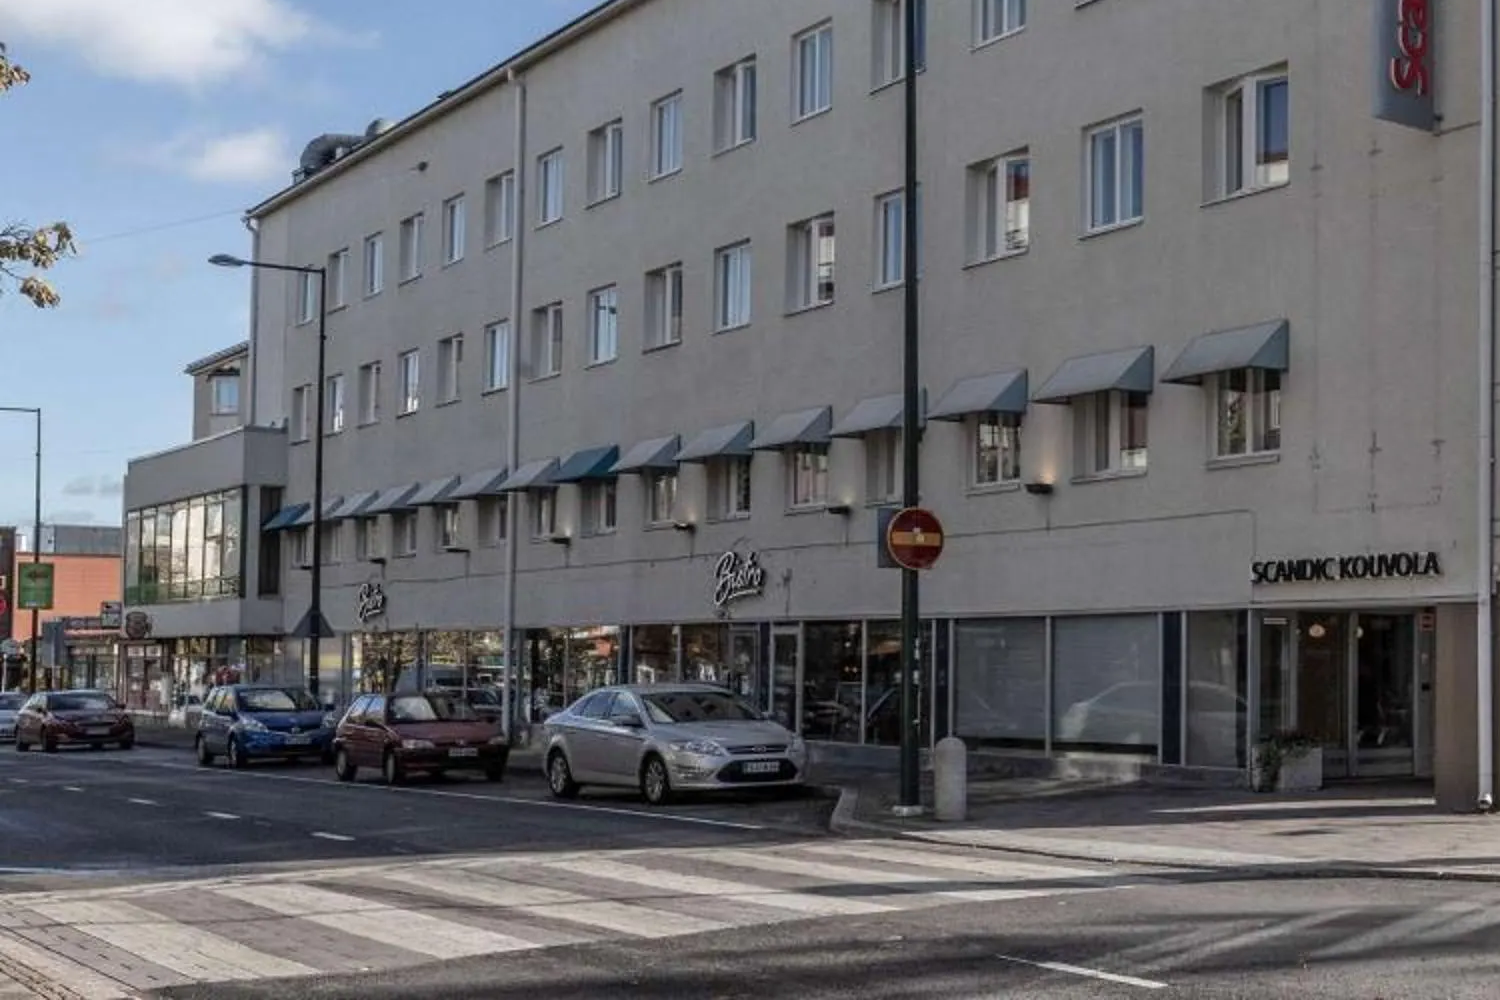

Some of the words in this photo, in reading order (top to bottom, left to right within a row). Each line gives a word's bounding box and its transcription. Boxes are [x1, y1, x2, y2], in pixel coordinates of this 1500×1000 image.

[714, 552, 762, 605] Bistro
[1251, 557, 1335, 584] SCANDIC
[1340, 552, 1441, 579] KOUVOLA
